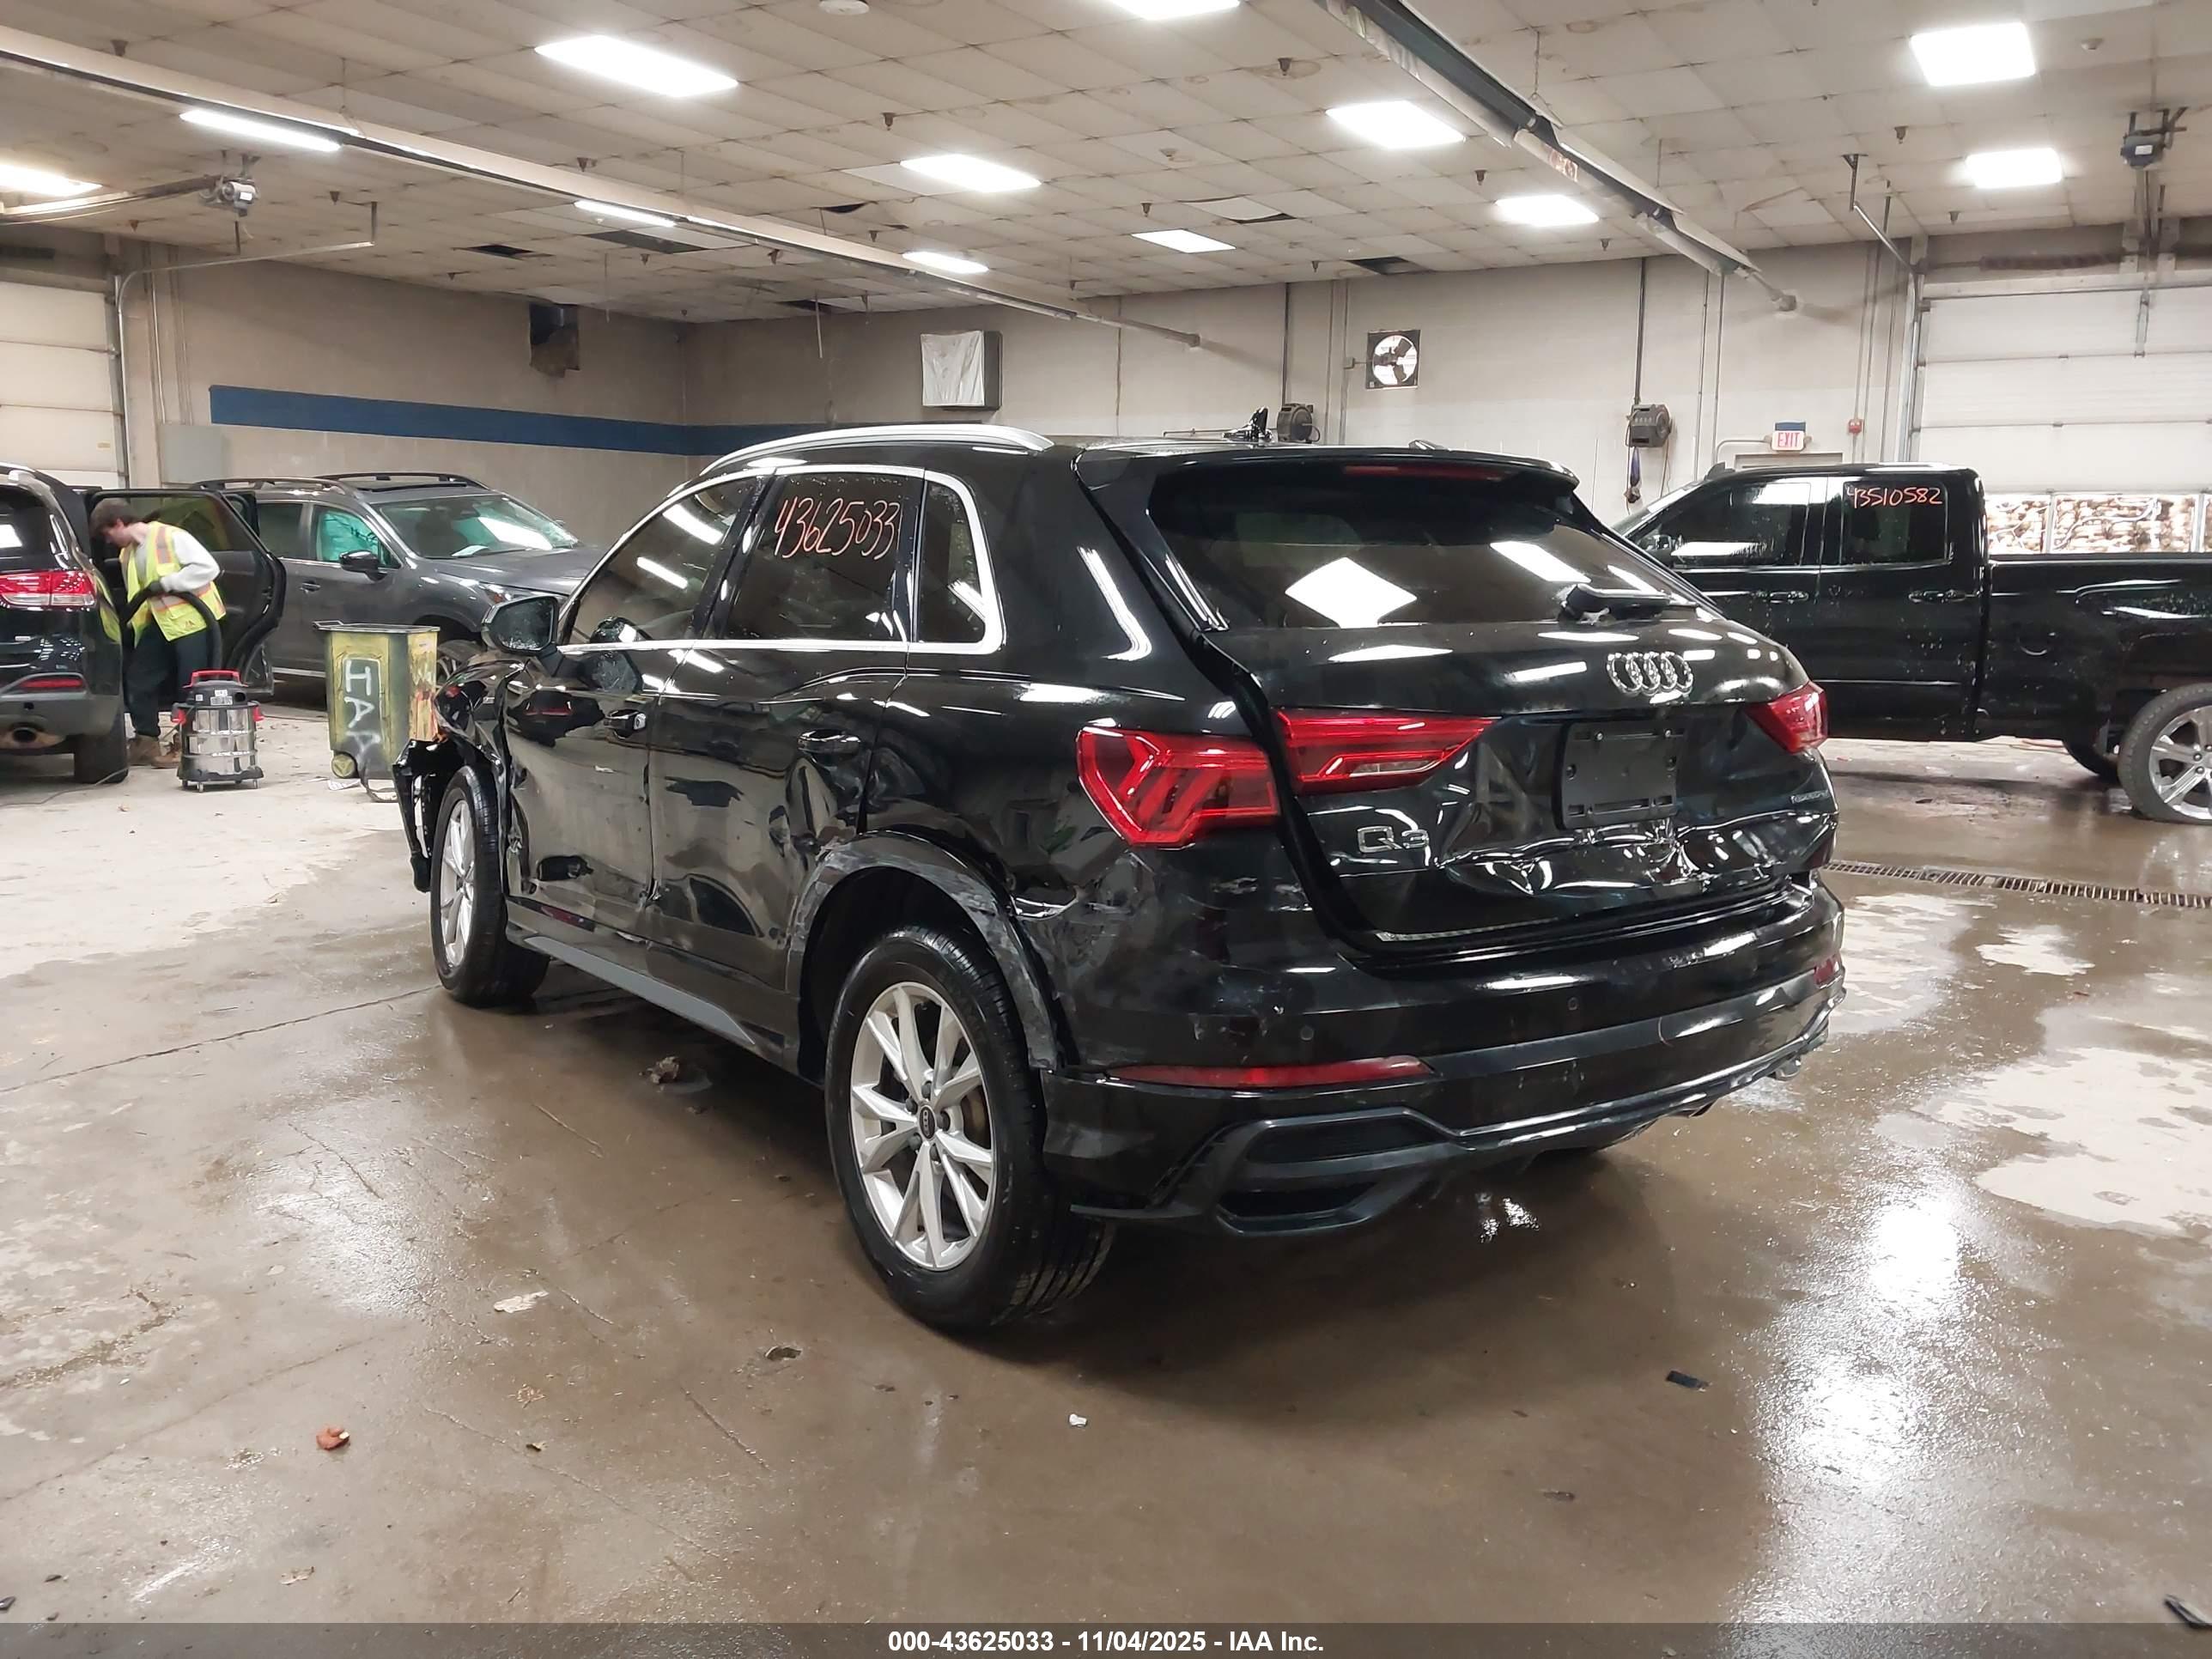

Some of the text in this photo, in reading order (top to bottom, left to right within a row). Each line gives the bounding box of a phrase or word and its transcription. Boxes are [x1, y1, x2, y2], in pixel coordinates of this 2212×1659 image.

[1778, 432, 1801, 447] EXIT
[1846, 486, 1942, 508] 43510582
[774, 496, 901, 561] 43625033
[1357, 825, 1430, 853] Q3
